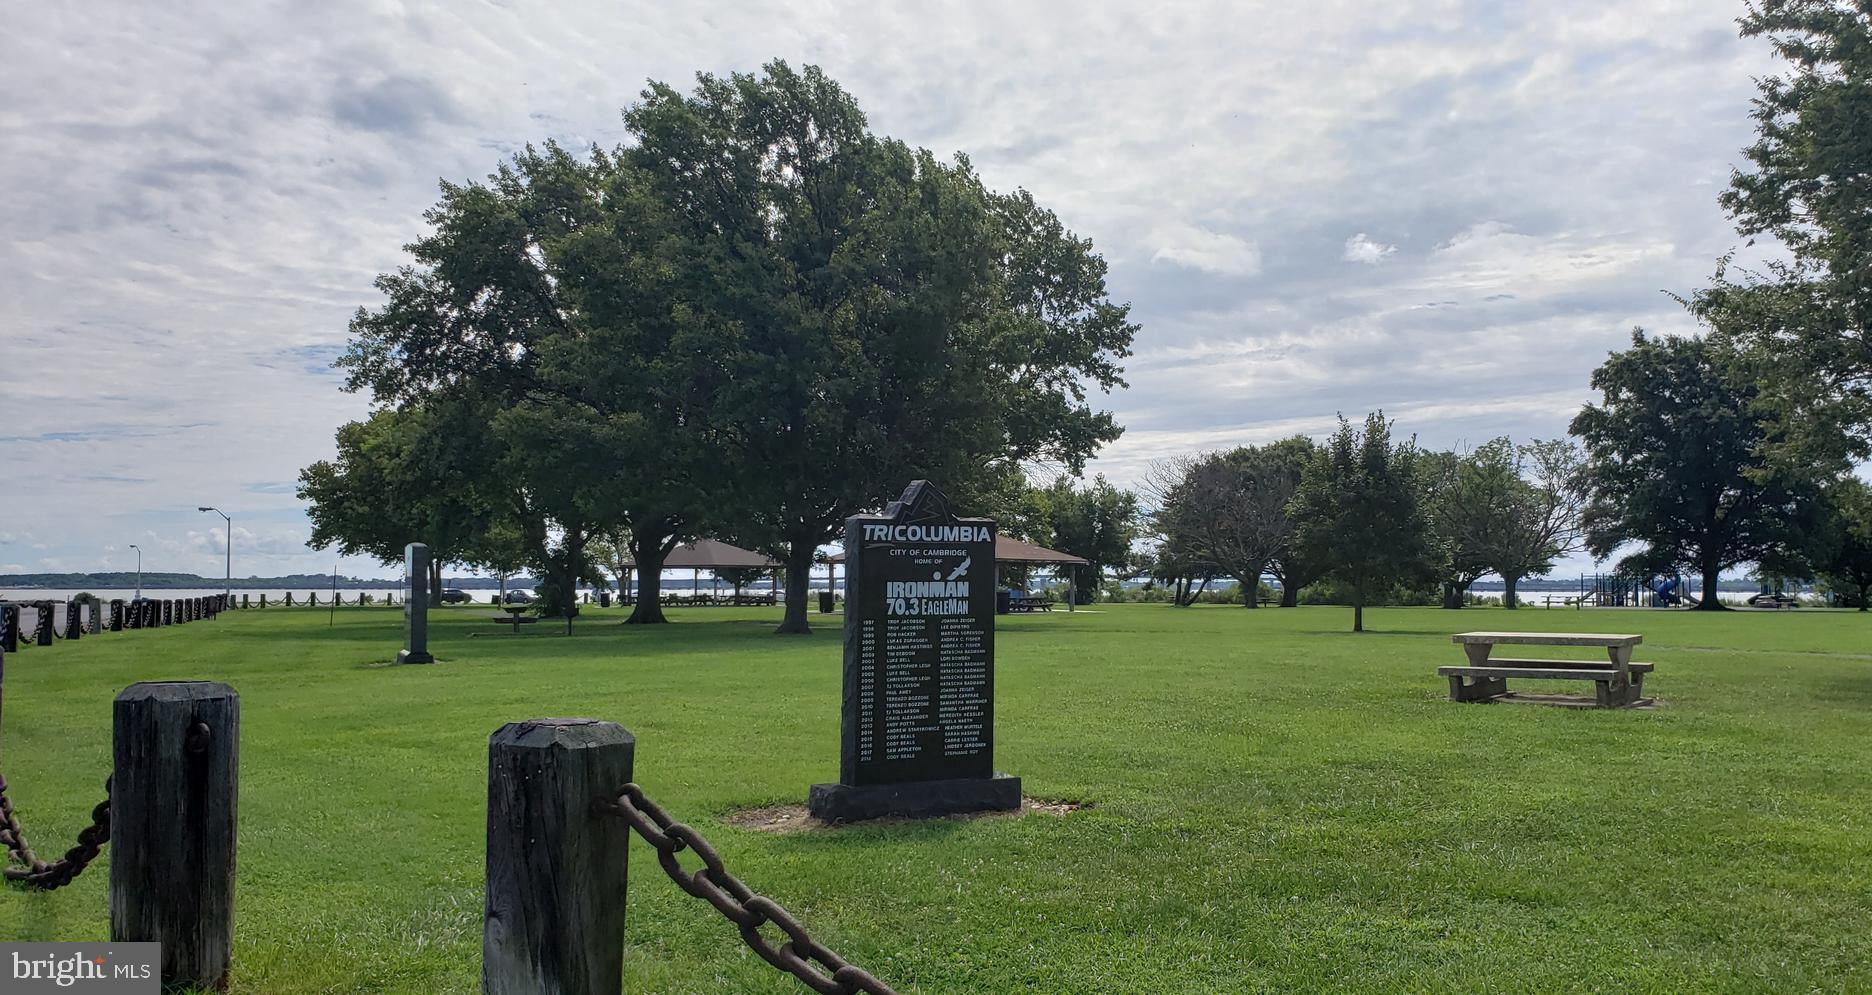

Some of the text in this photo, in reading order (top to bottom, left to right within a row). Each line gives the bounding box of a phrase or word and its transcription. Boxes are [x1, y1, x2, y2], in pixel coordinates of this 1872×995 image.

[863, 524, 991, 542] TRICOLUMBIA
[887, 581, 969, 598] IRONMAN
[886, 599, 969, 615] 70.3 EAGLEMAN
